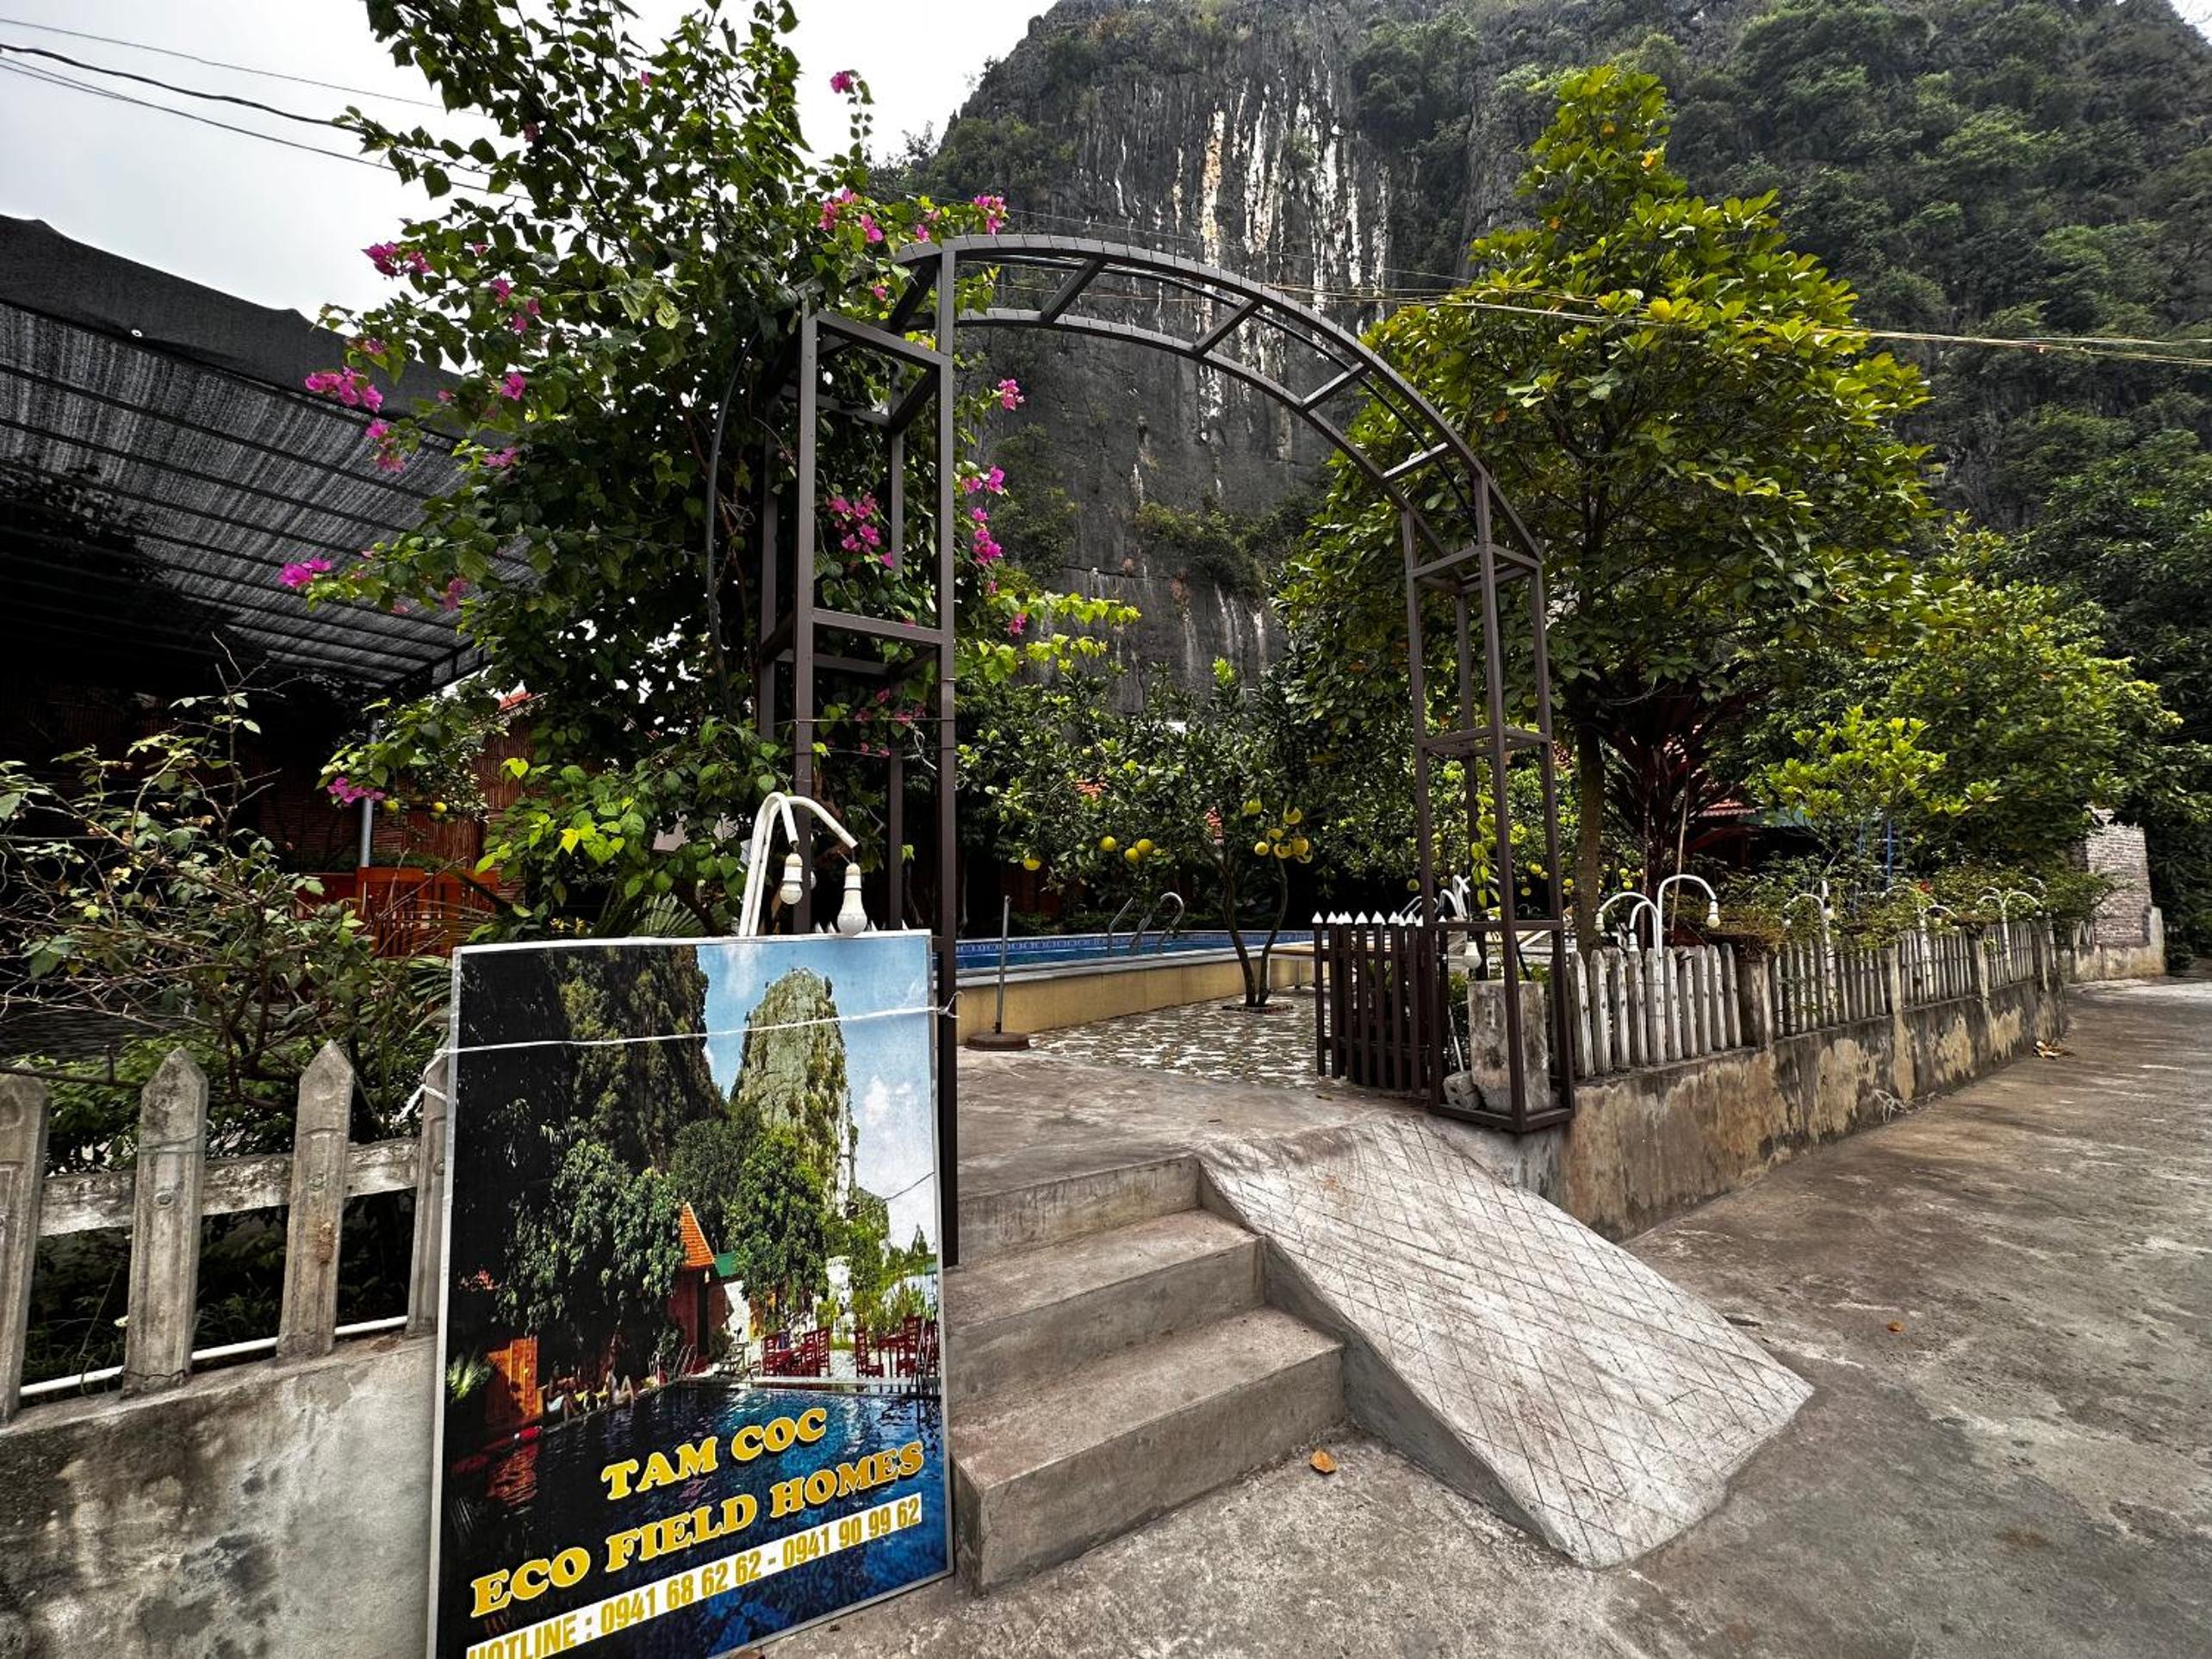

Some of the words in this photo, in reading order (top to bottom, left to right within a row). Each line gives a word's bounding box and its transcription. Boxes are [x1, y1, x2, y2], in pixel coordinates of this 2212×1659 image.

[601, 1436, 718, 1500] TAM
[730, 1407, 827, 1461] COC
[470, 1547, 591, 1618] ECO
[605, 1494, 758, 1573] FIELD
[770, 1441, 923, 1518] HOMES
[601, 1587, 656, 1634] 0941
[666, 1574, 693, 1610] 68
[701, 1562, 728, 1597] 62
[736, 1550, 761, 1585] 62
[783, 1526, 830, 1569] 0941
[838, 1516, 861, 1548] 90
[868, 1507, 891, 1538] 99
[897, 1497, 919, 1529] 62
